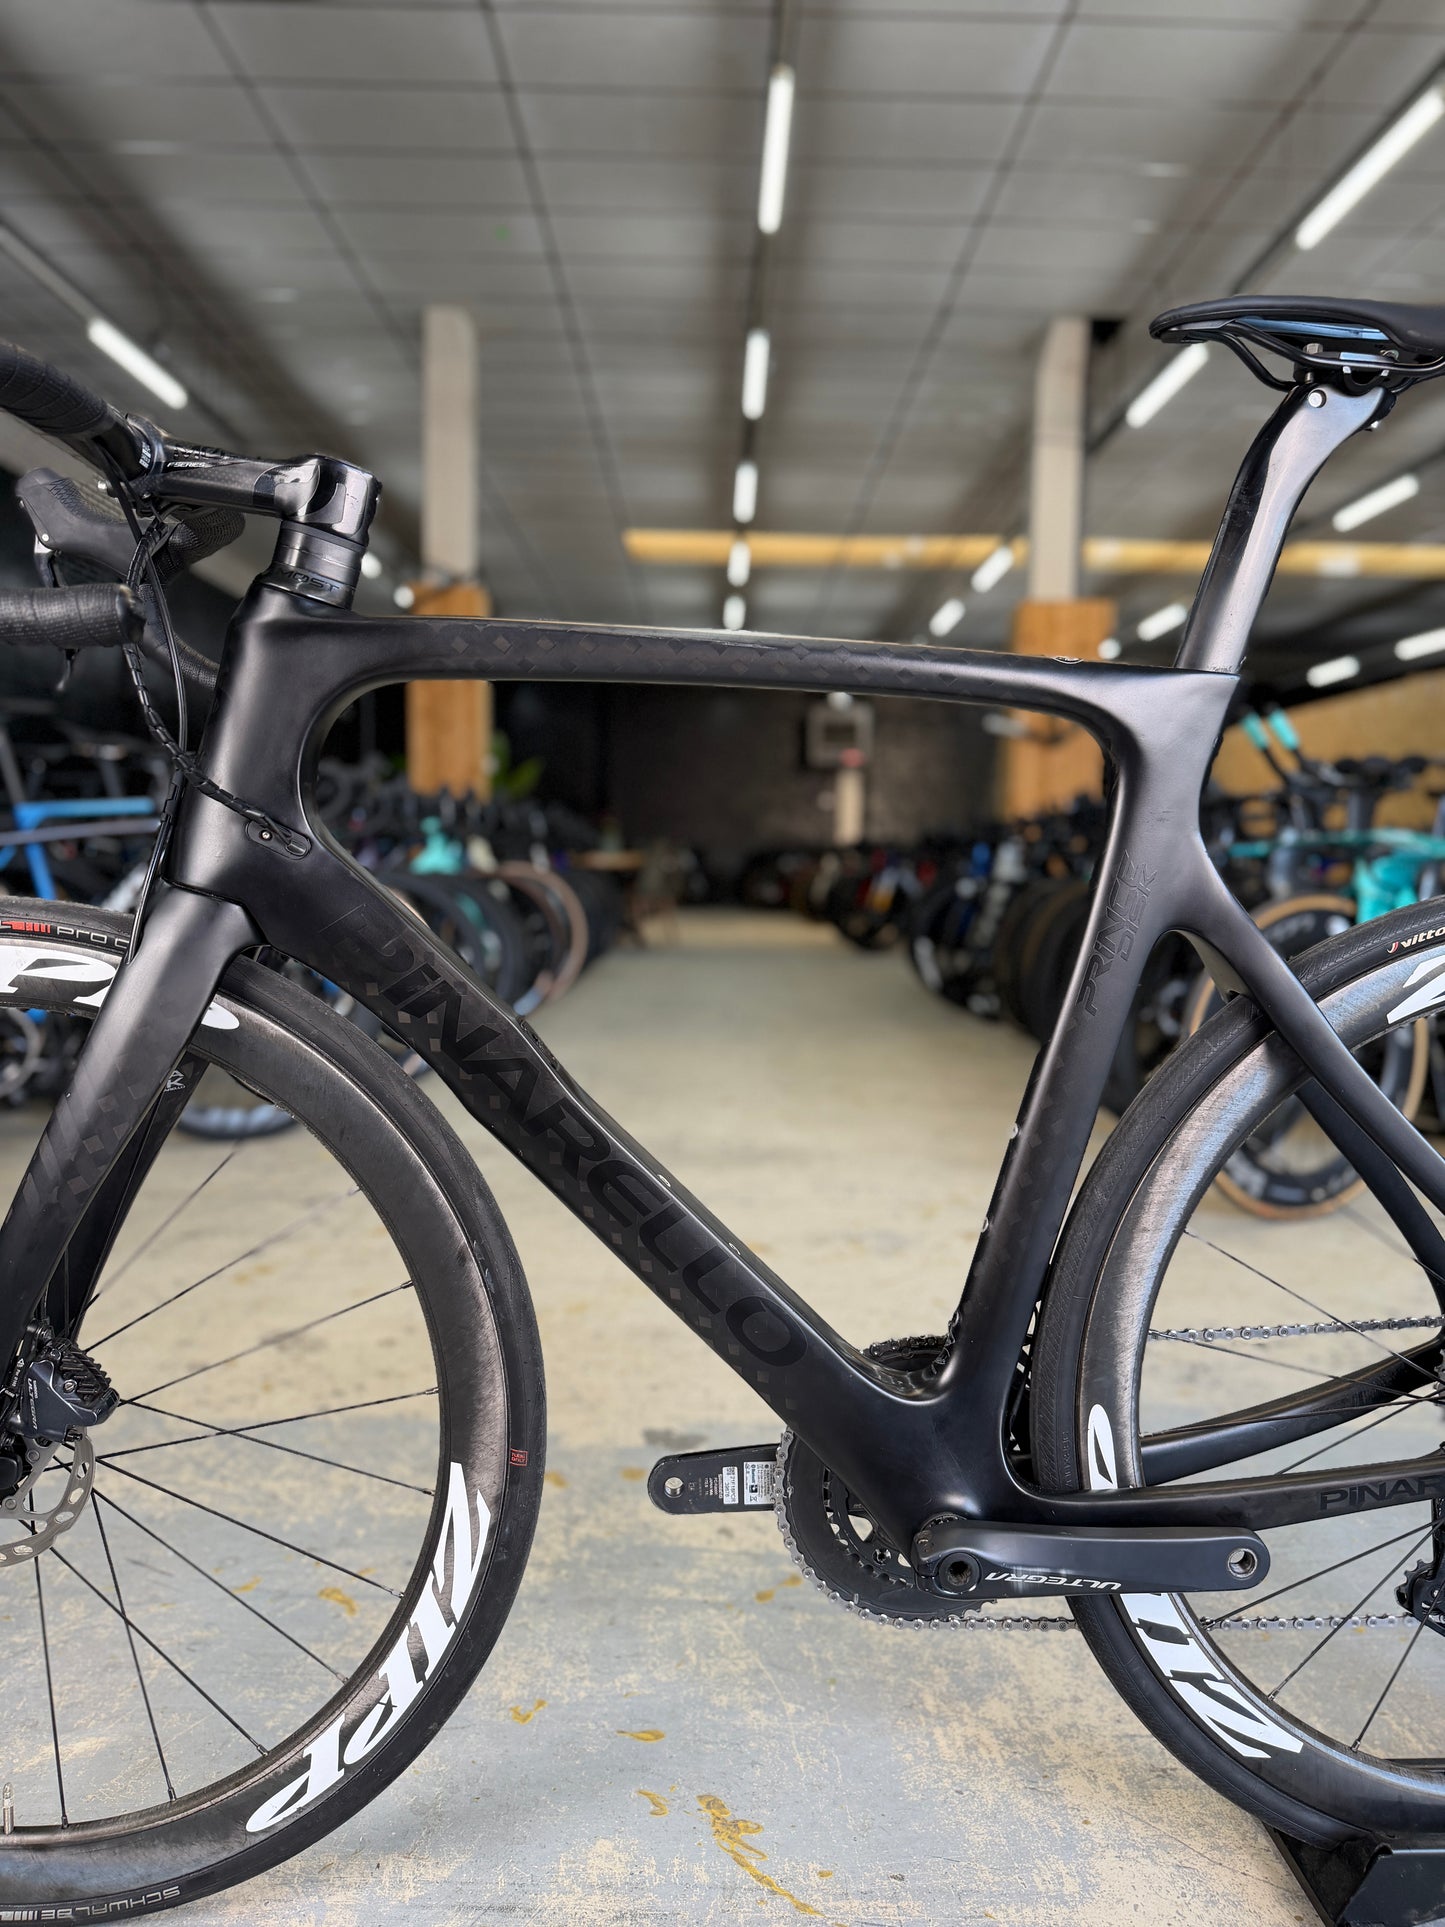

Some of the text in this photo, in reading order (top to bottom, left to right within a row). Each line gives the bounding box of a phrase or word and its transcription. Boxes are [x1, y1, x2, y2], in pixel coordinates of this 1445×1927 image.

[279, 568, 340, 593] MOST
[318, 903, 808, 1367] PINARELLO
[28, 1377, 38, 1430] ULTEGRA
[985, 1572, 1122, 1591] ULTEGRA
[245, 1462, 492, 1833] ZIPP
[40, 1886, 182, 1921] SCHWALBE
